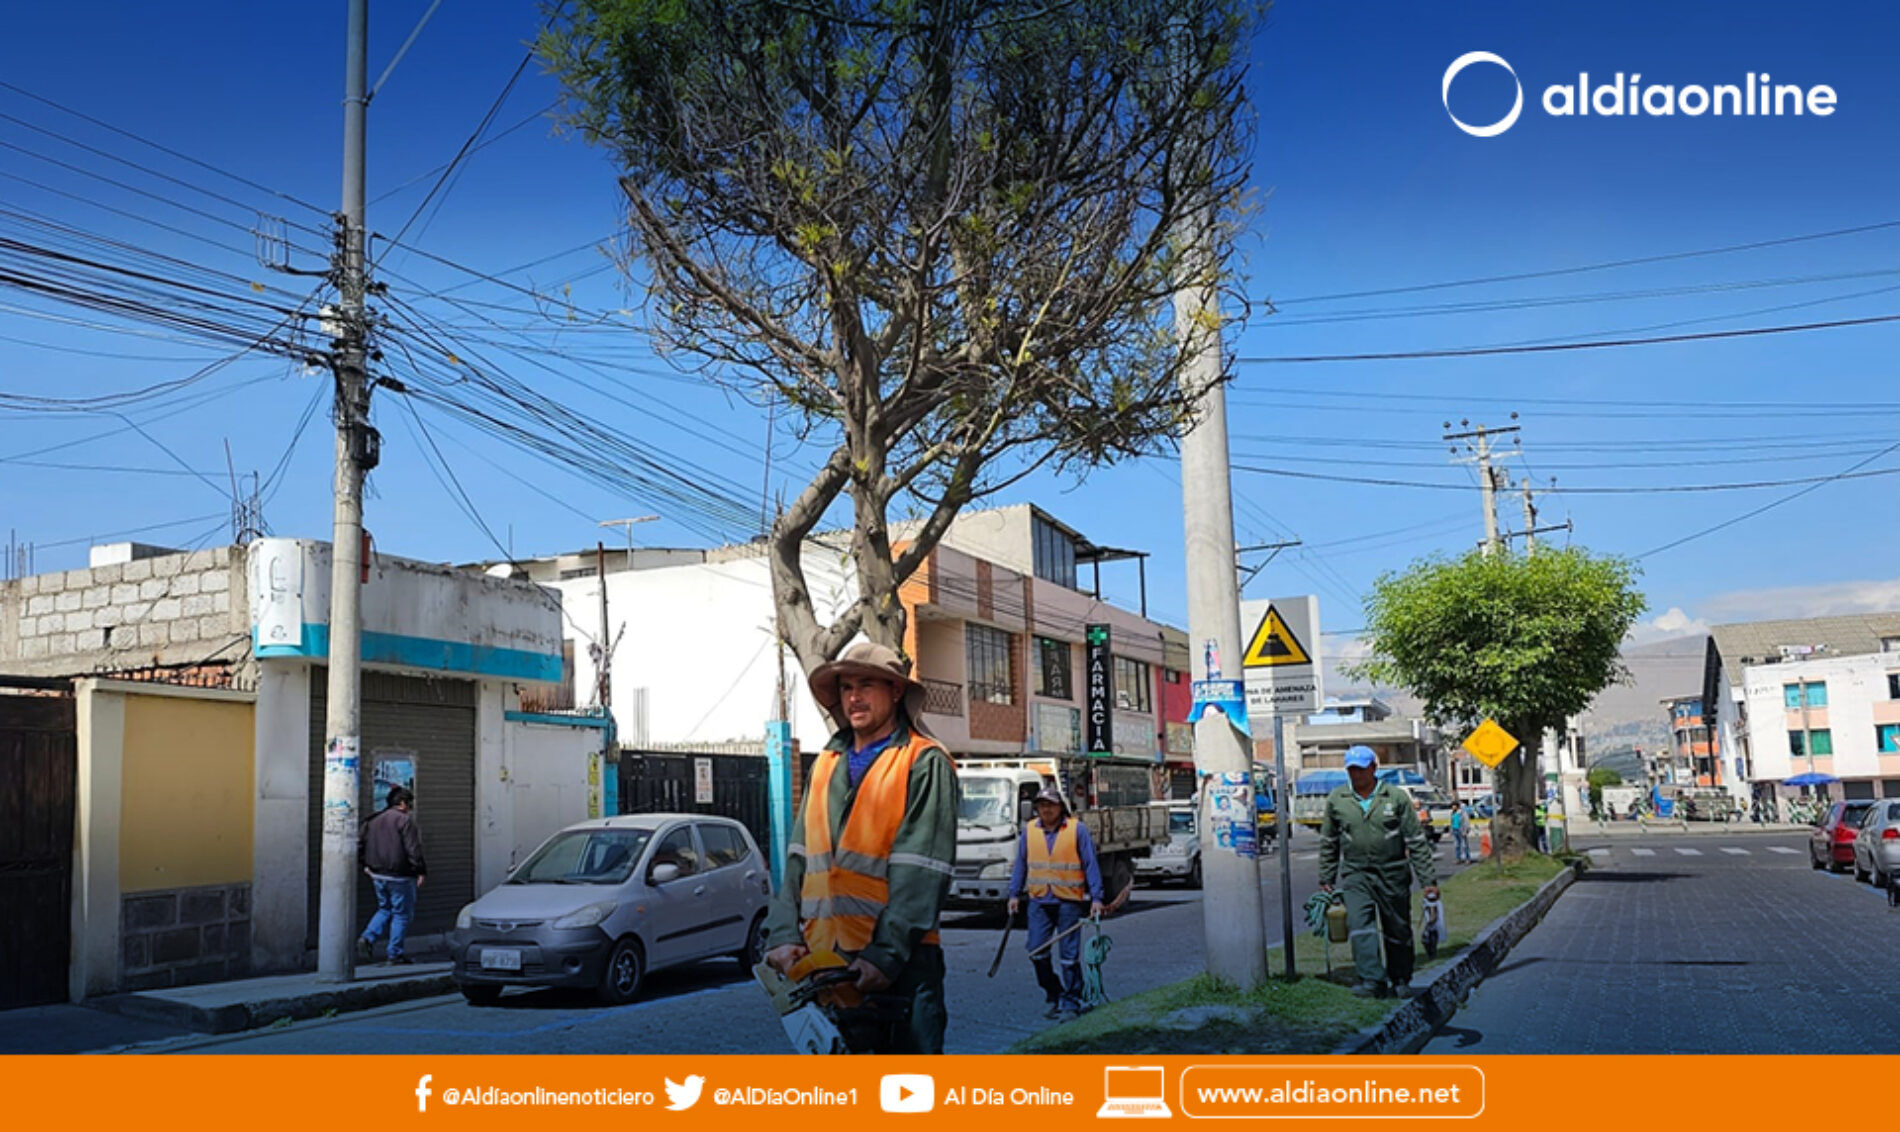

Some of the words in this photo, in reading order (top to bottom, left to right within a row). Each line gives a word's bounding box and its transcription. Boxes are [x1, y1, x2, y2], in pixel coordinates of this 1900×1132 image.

[1091, 648, 1106, 751] FARMACIA
[1260, 687, 1271, 695] DE
[1274, 684, 1316, 693] AMENAZA
